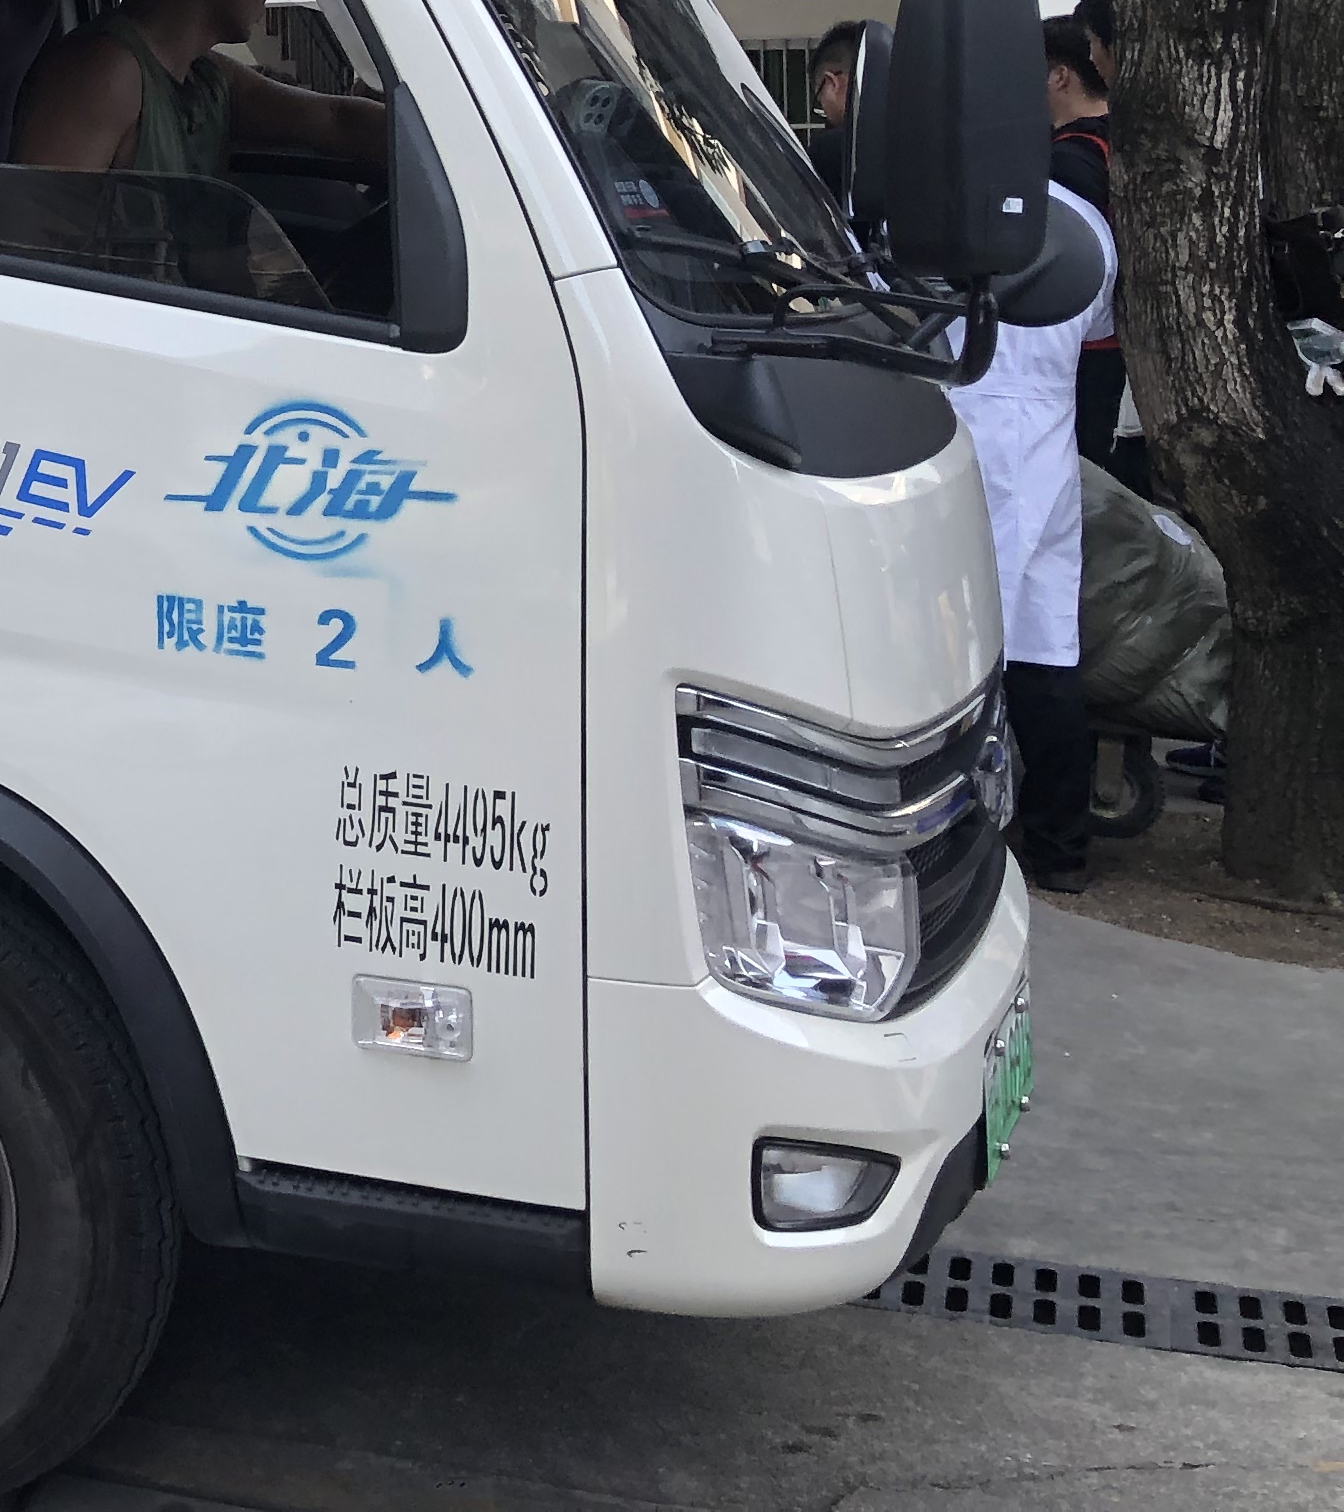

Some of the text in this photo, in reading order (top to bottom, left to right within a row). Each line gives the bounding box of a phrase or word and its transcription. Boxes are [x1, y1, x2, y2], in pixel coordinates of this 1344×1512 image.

[163, 431, 459, 523] 北海
[335, 765, 551, 899] 总质量4495kg
[333, 874, 538, 981] 栏板高400mm
